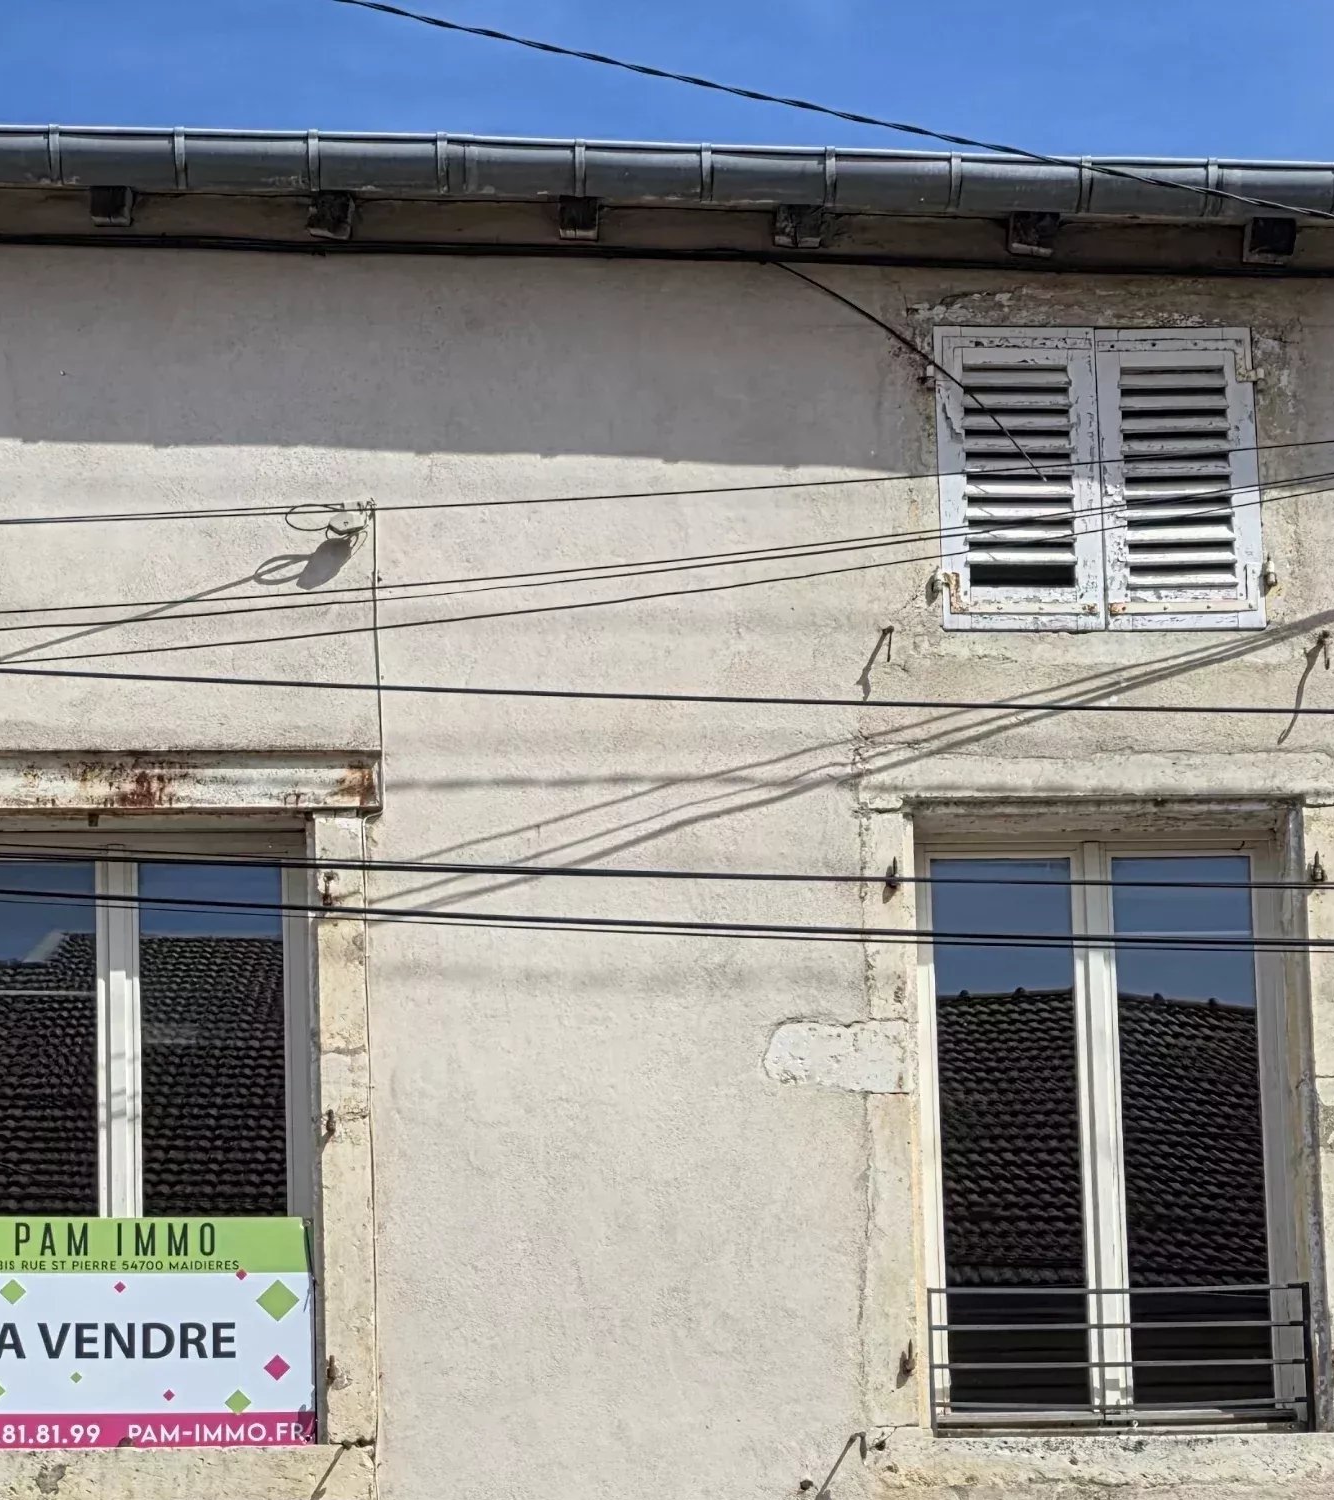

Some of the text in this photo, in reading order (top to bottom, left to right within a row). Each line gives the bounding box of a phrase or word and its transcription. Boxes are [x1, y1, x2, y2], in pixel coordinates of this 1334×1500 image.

[14, 1222, 216, 1257] PAM IMMO
[21, 1260, 46, 1271] RUE
[51, 1260, 67, 1271] ST
[71, 1260, 117, 1271] PIERRE
[122, 1260, 164, 1271] 54700
[168, 1259, 240, 1271] MAIDIERES
[37, 1321, 237, 1359] VENDRE
[128, 1421, 305, 1444] PAM-IMMO.FR
